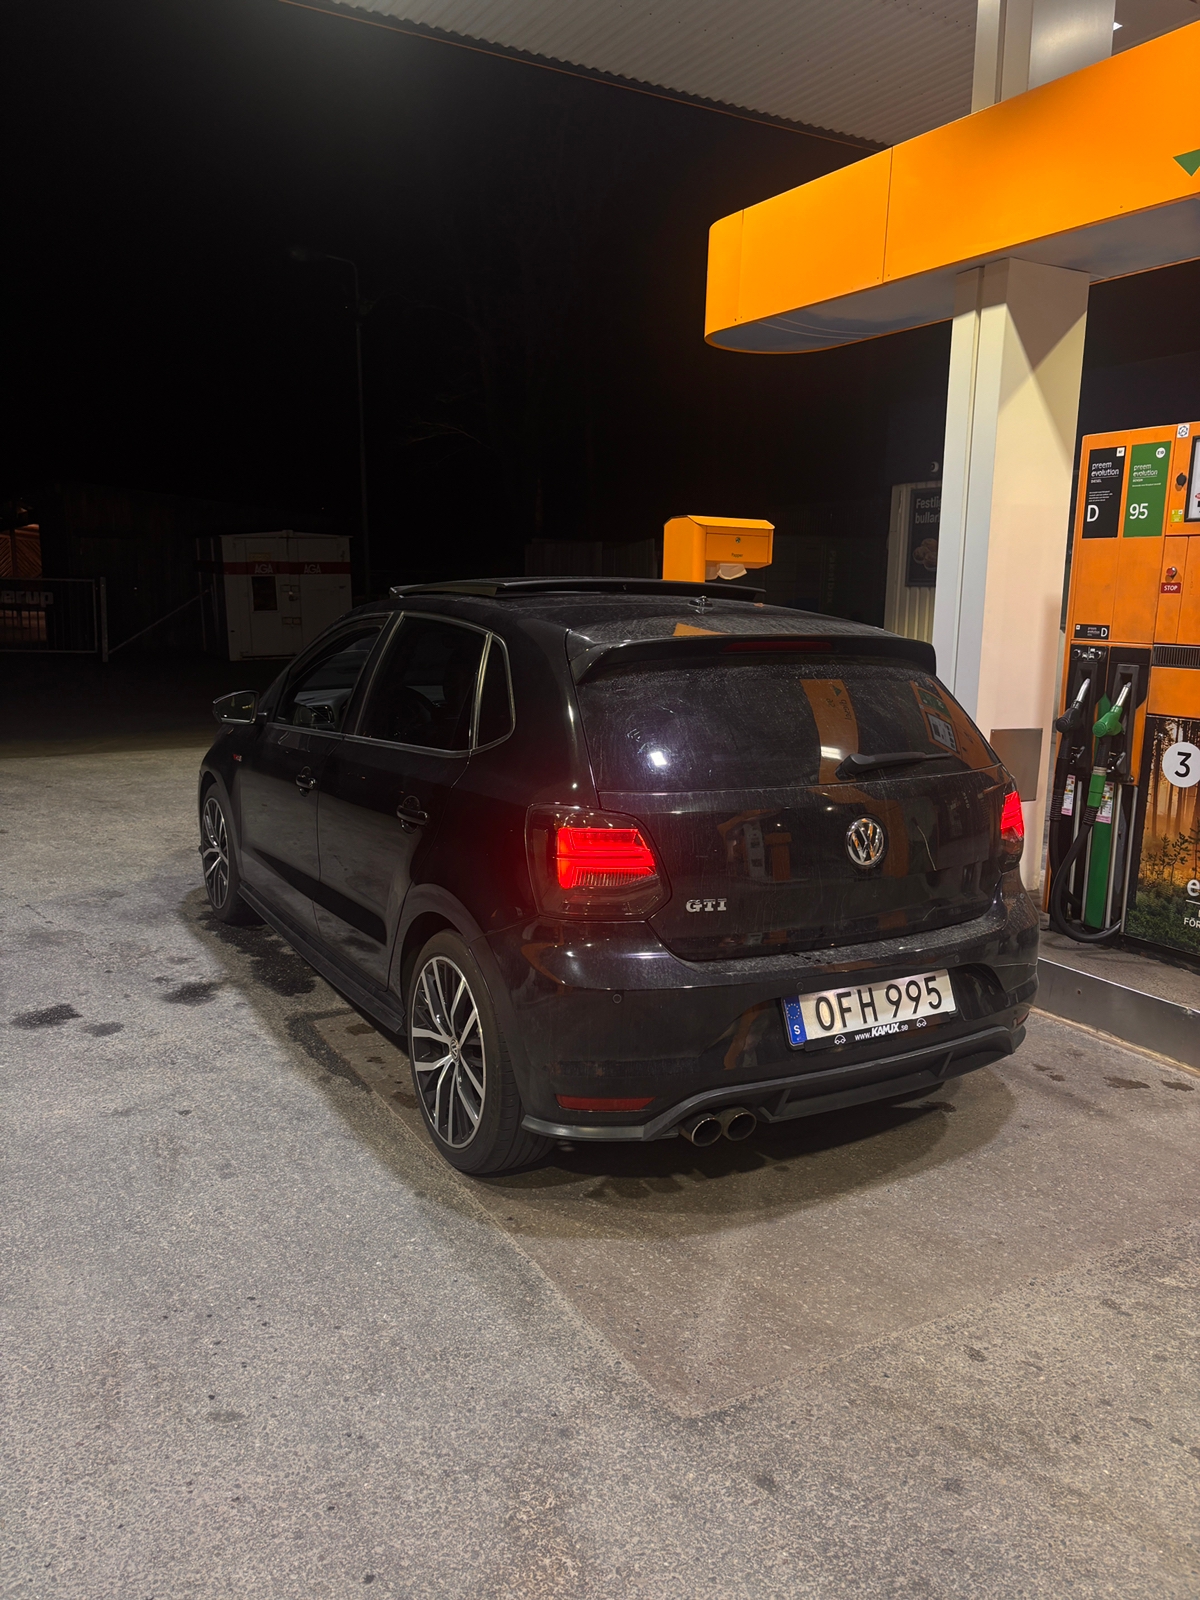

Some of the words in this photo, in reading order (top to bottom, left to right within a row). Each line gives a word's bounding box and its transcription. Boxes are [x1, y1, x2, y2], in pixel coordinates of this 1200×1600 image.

[1091, 461, 1112, 470] preem
[1091, 468, 1120, 477] evolution
[1132, 469, 1158, 477] evolution
[1086, 504, 1099, 523] D
[1129, 503, 1149, 520] 95
[254, 563, 274, 574] AGA
[303, 563, 322, 574] AGA
[1100, 627, 1108, 637] D
[1174, 751, 1192, 778] 3
[685, 897, 728, 913] GTI
[815, 987, 879, 1031] OFH
[885, 975, 942, 1018] 995
[793, 1025, 801, 1035] S
